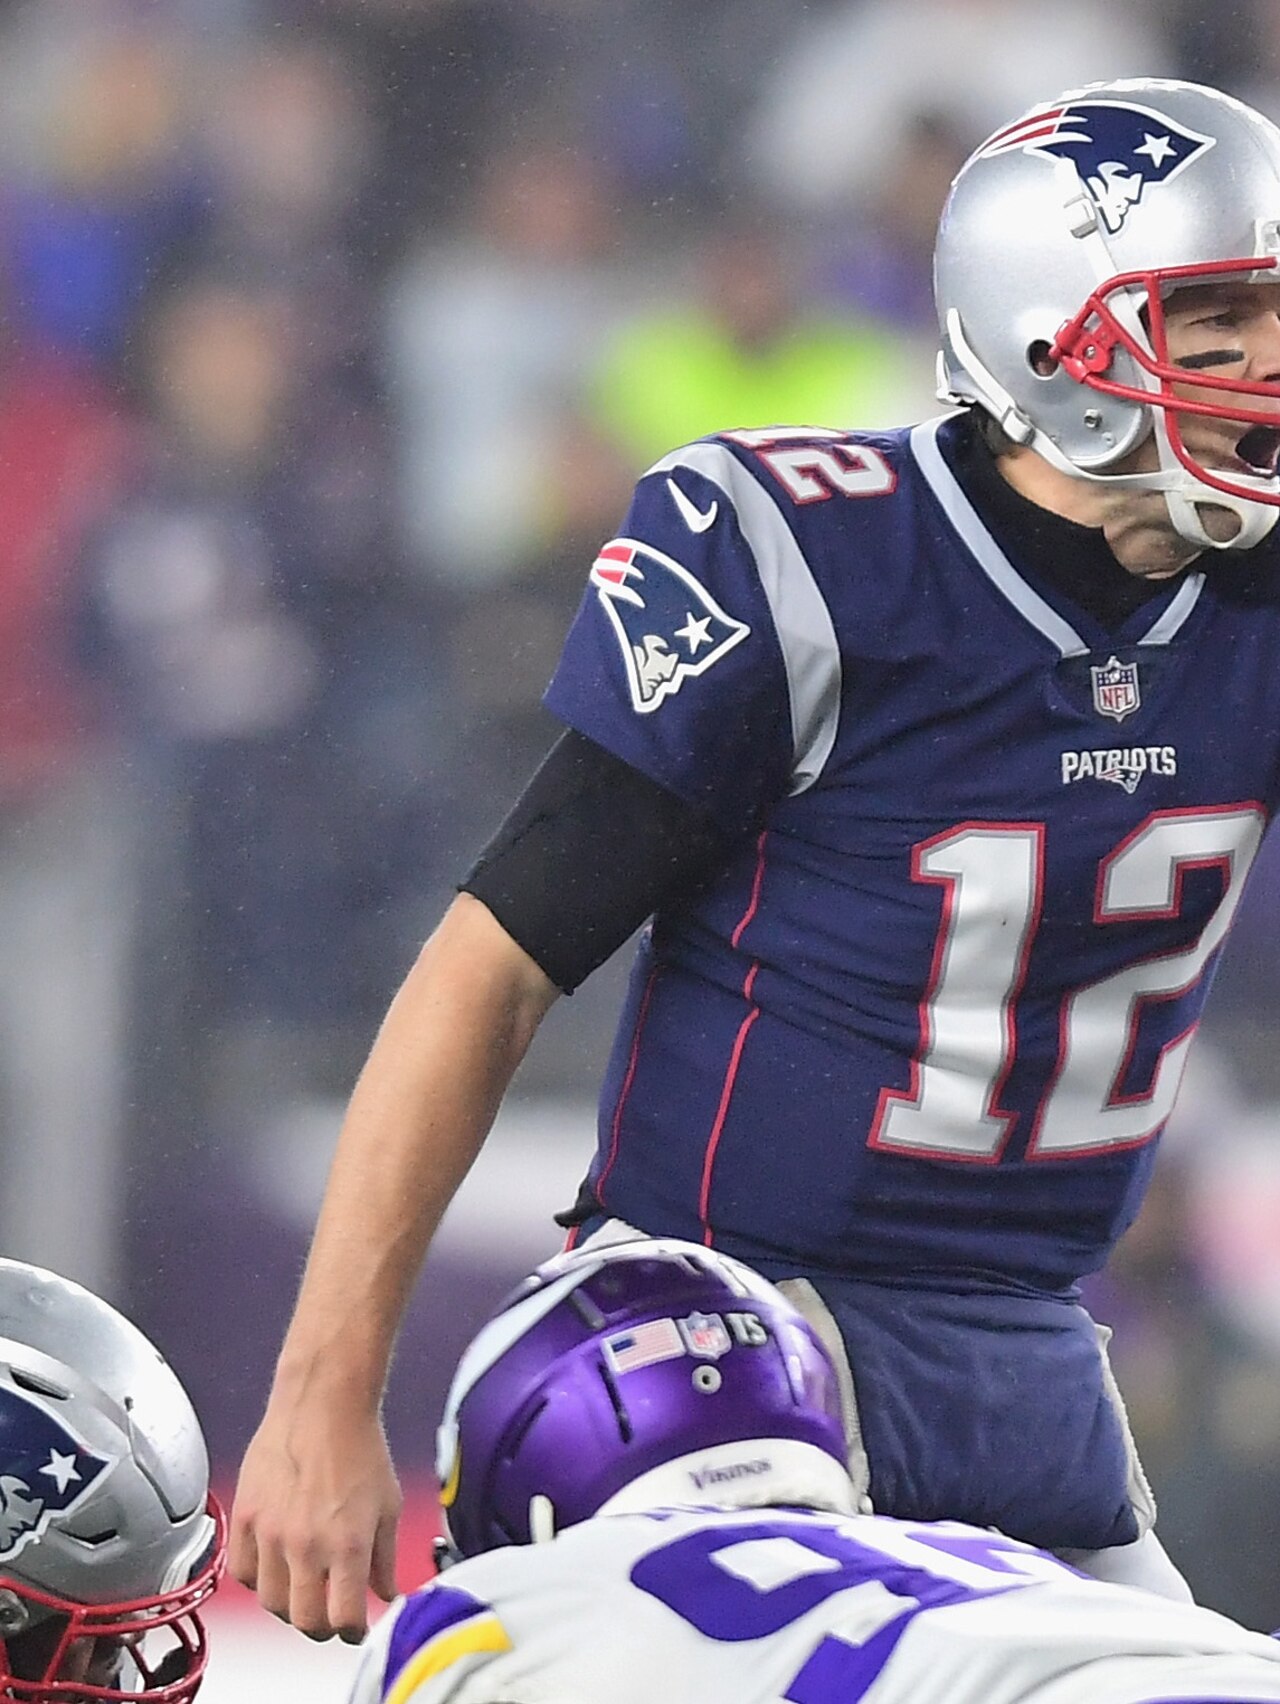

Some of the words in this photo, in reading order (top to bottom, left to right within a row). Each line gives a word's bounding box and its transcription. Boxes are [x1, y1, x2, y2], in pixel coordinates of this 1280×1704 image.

[1102, 686, 1132, 709] NFL
[1061, 746, 1177, 784] PATRIOTS
[866, 801, 1266, 1164] 12
